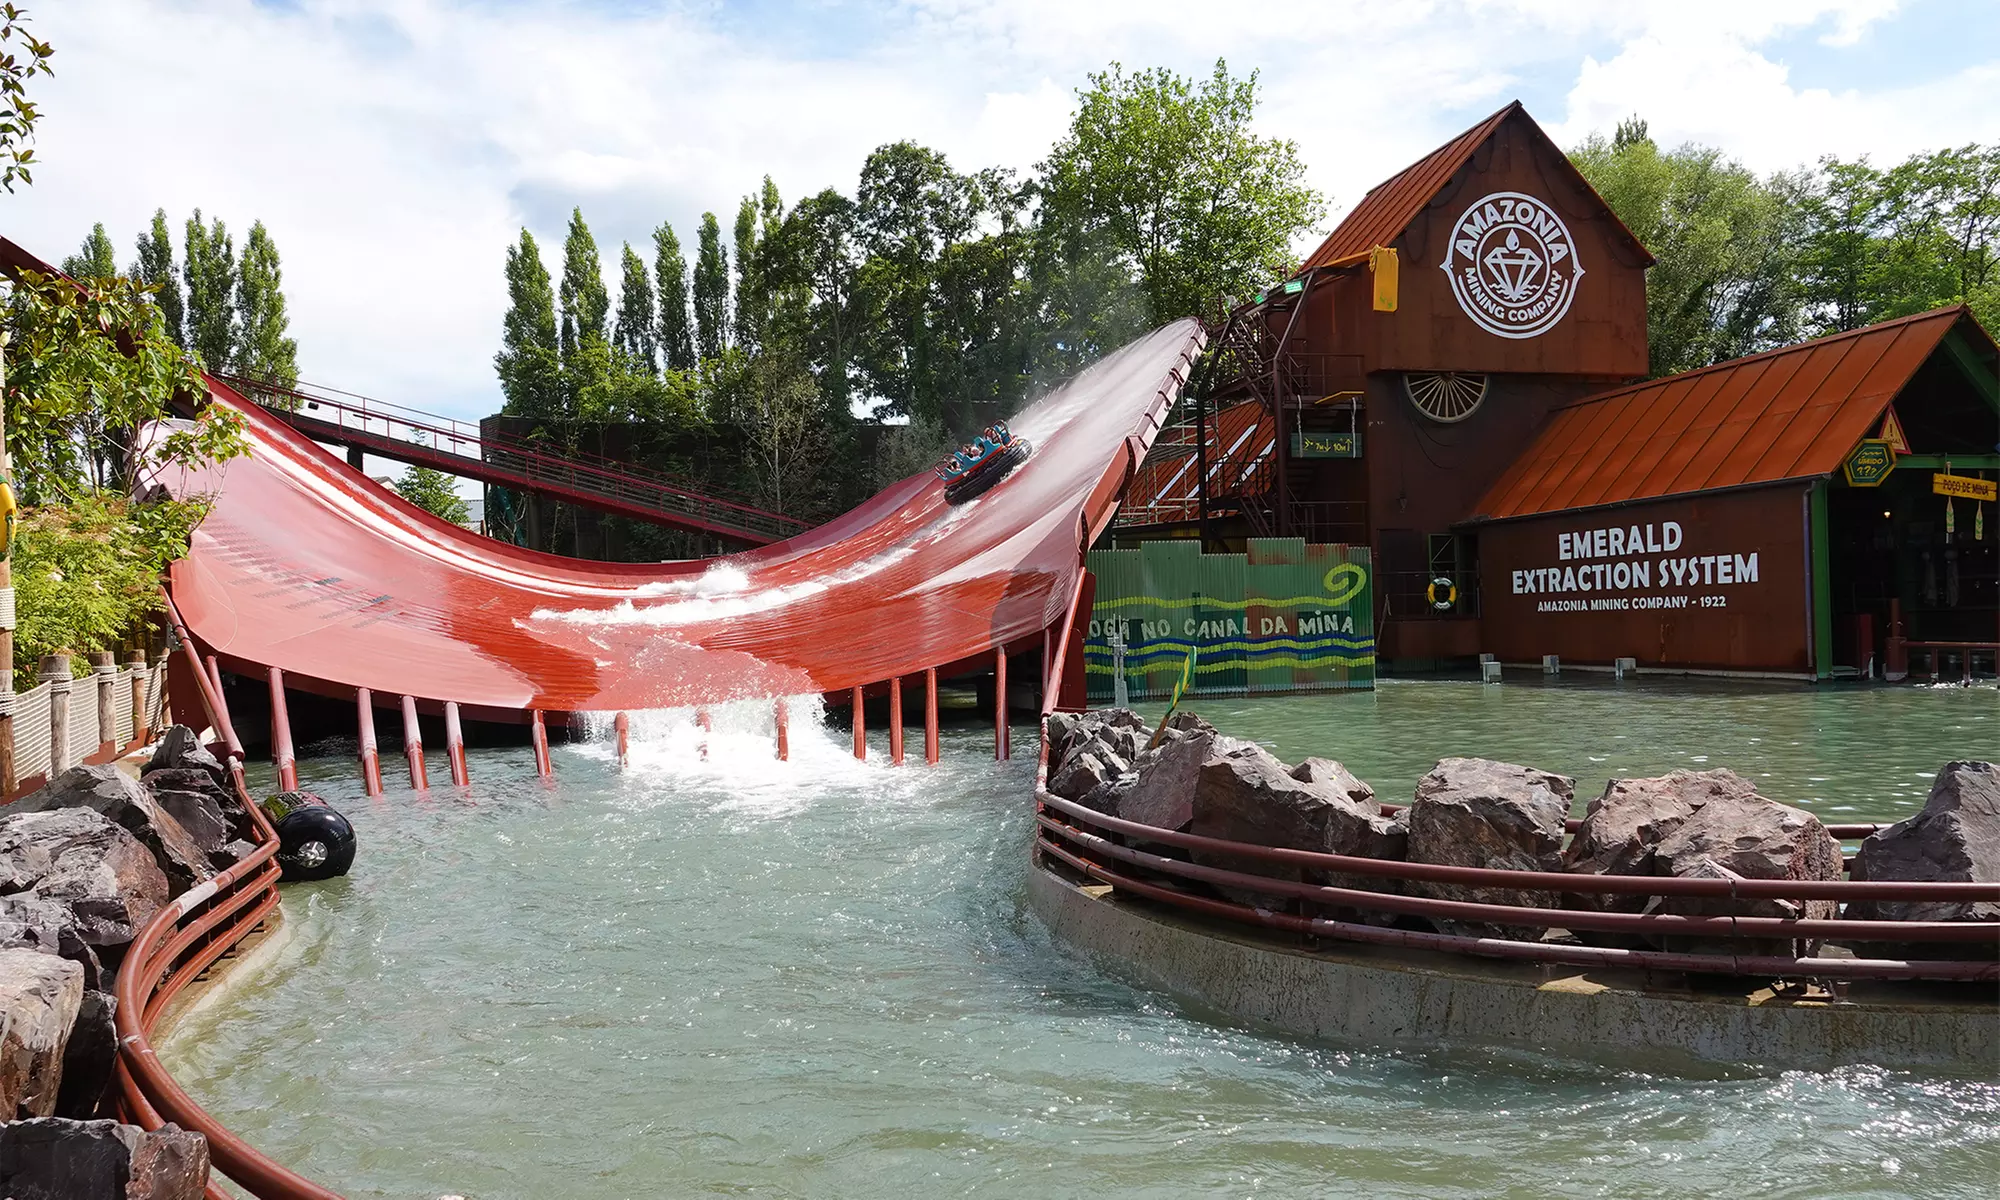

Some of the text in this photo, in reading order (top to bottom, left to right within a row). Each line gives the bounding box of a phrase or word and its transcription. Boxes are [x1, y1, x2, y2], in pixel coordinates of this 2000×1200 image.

[1455, 200, 1569, 265] AMAZONIA
[1465, 267, 1562, 322] MINING COMPANY
[1962, 482, 1971, 493] DE
[1558, 521, 1683, 560] EMERALD
[1512, 552, 1759, 594] EXTRACTION SYSTEM
[1537, 600, 1588, 612] AMAZONIA
[1590, 598, 1629, 611] MINING
[1632, 596, 1688, 610] COMPANY
[1700, 595, 1727, 608] 1922
[1141, 619, 1171, 640] NO
[1184, 617, 1252, 639] CANAL
[1260, 615, 1289, 636] DA
